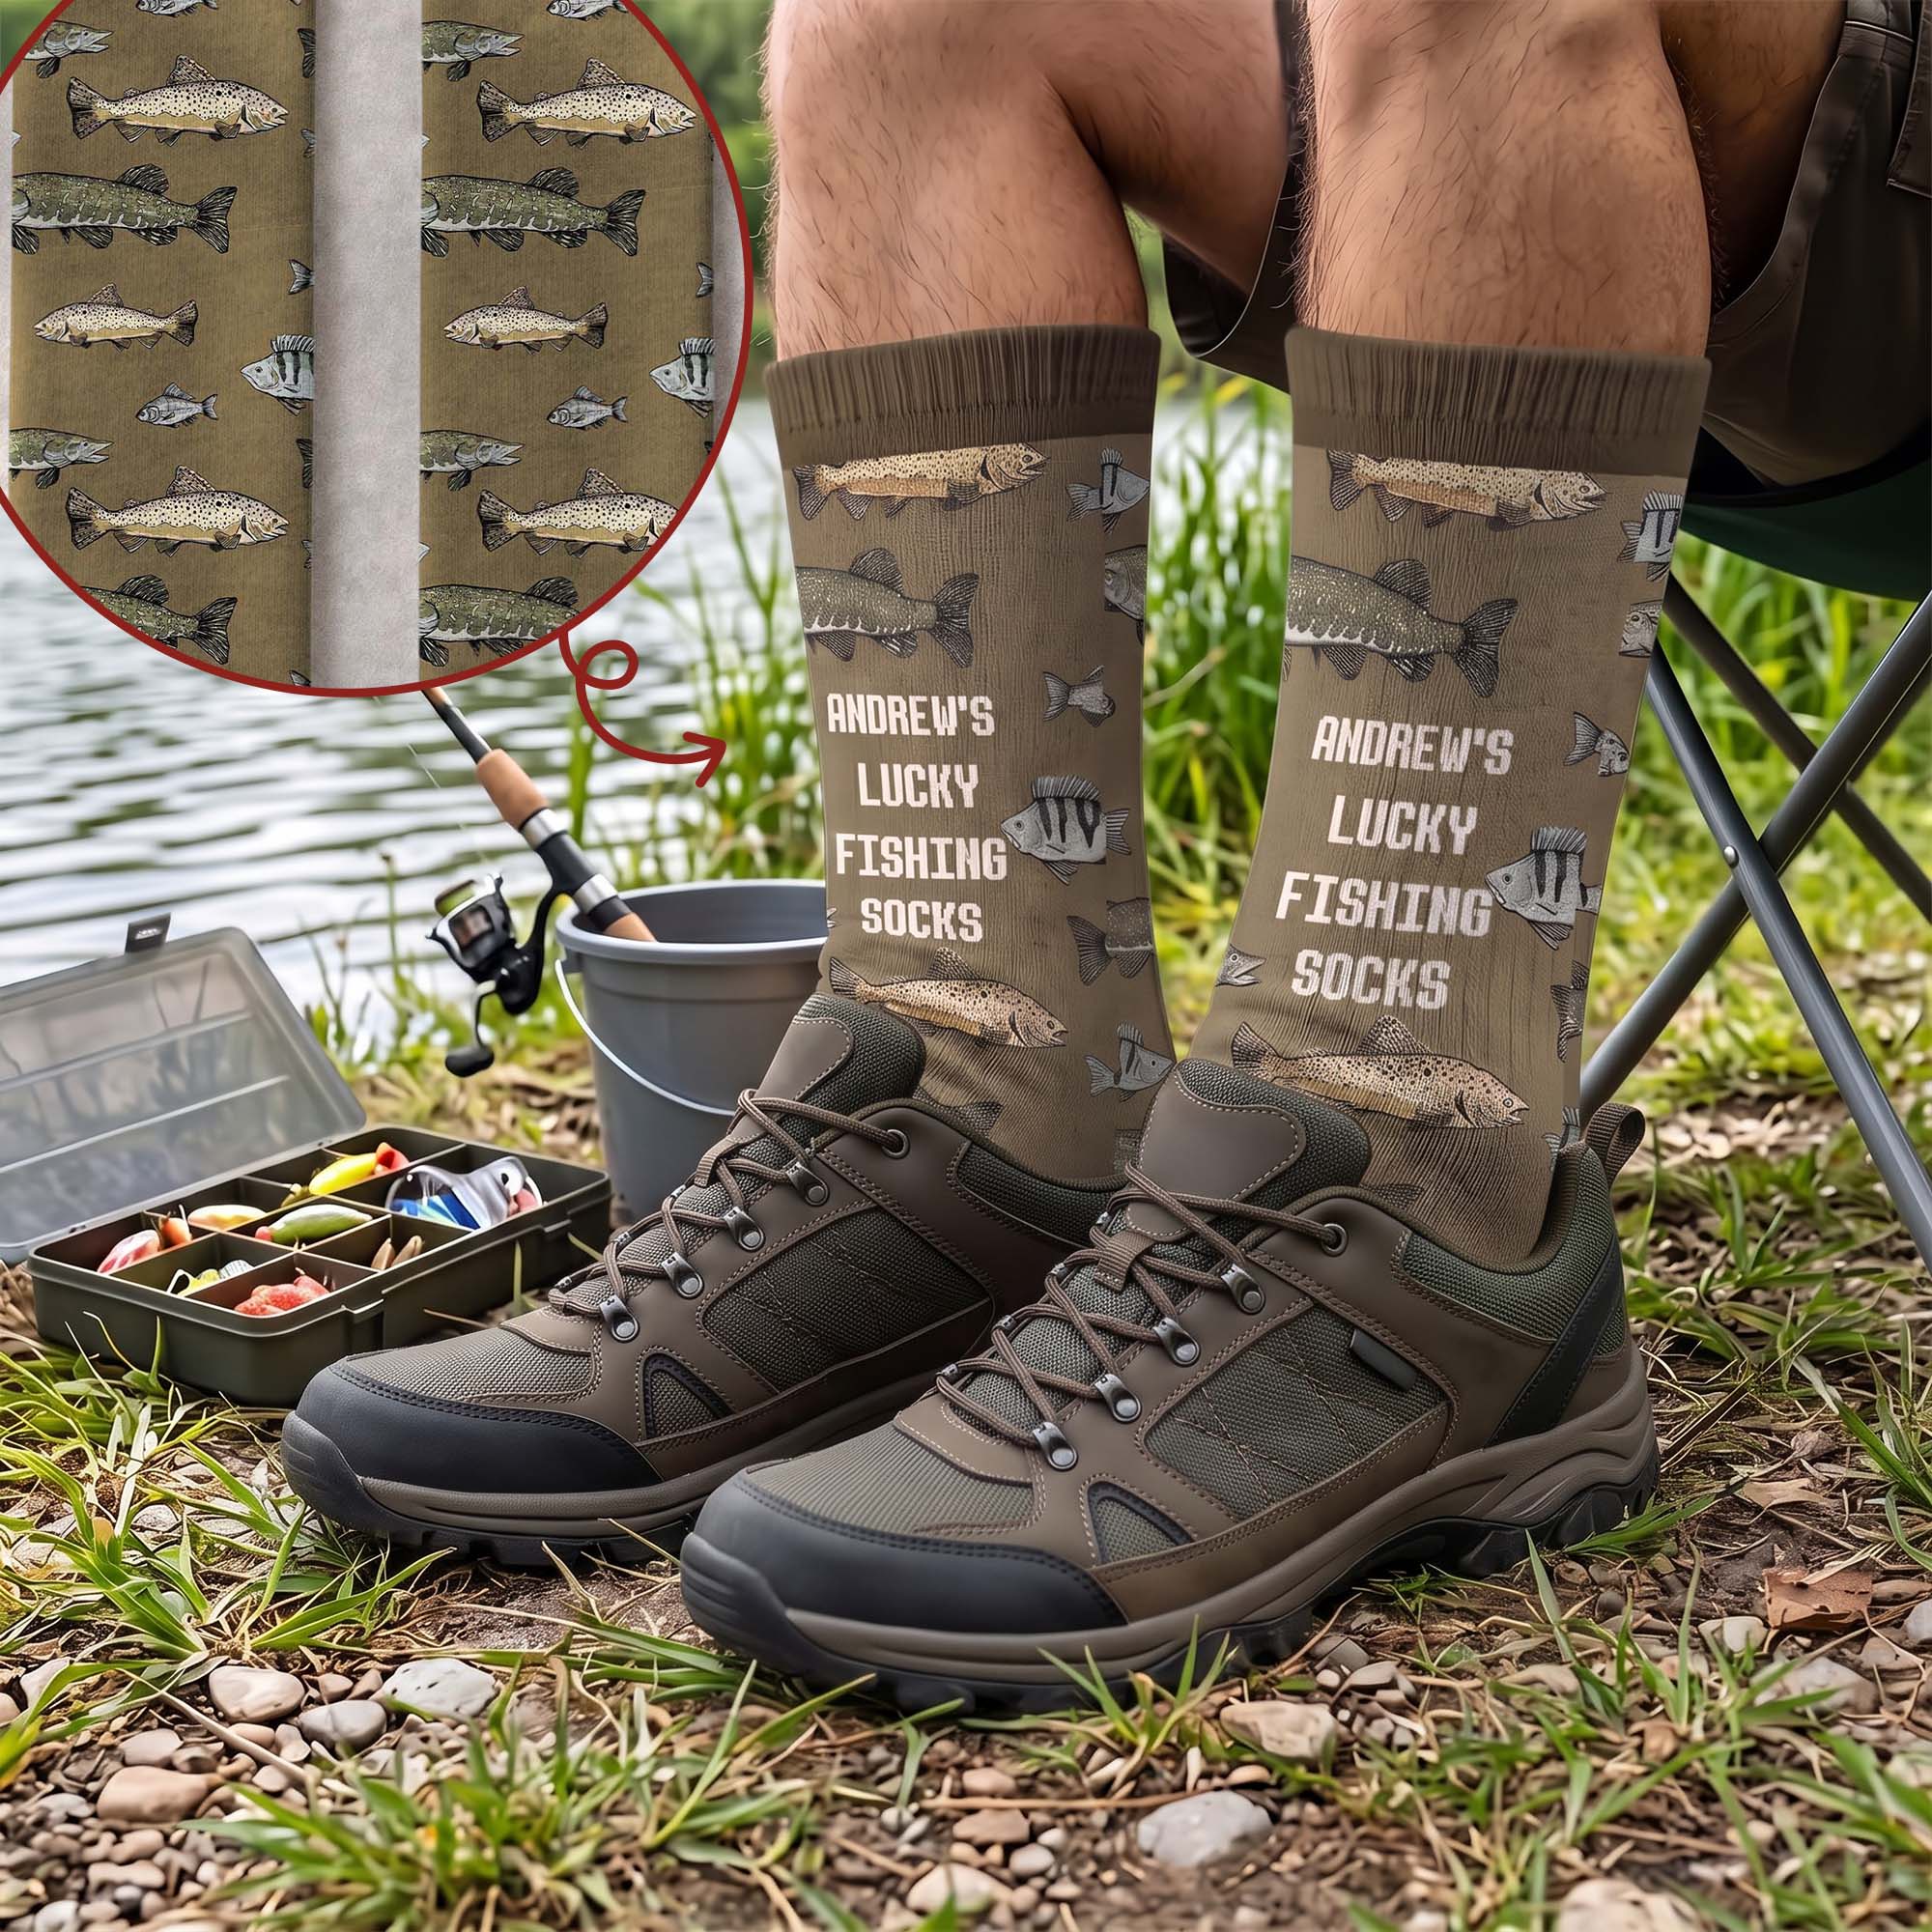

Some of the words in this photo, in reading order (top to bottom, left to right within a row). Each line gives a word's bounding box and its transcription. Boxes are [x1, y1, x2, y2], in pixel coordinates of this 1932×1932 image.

[827, 693, 995, 736] ANDREW'S
[1311, 715, 1515, 775] ANDREW'S
[858, 762, 979, 808] LUCKY
[1327, 795, 1478, 855] LUCKY
[836, 833, 1008, 881] FISHING
[861, 897, 983, 943] SOCKS
[1275, 870, 1493, 937] FISHING
[1291, 949, 1450, 1009] SOCKS
